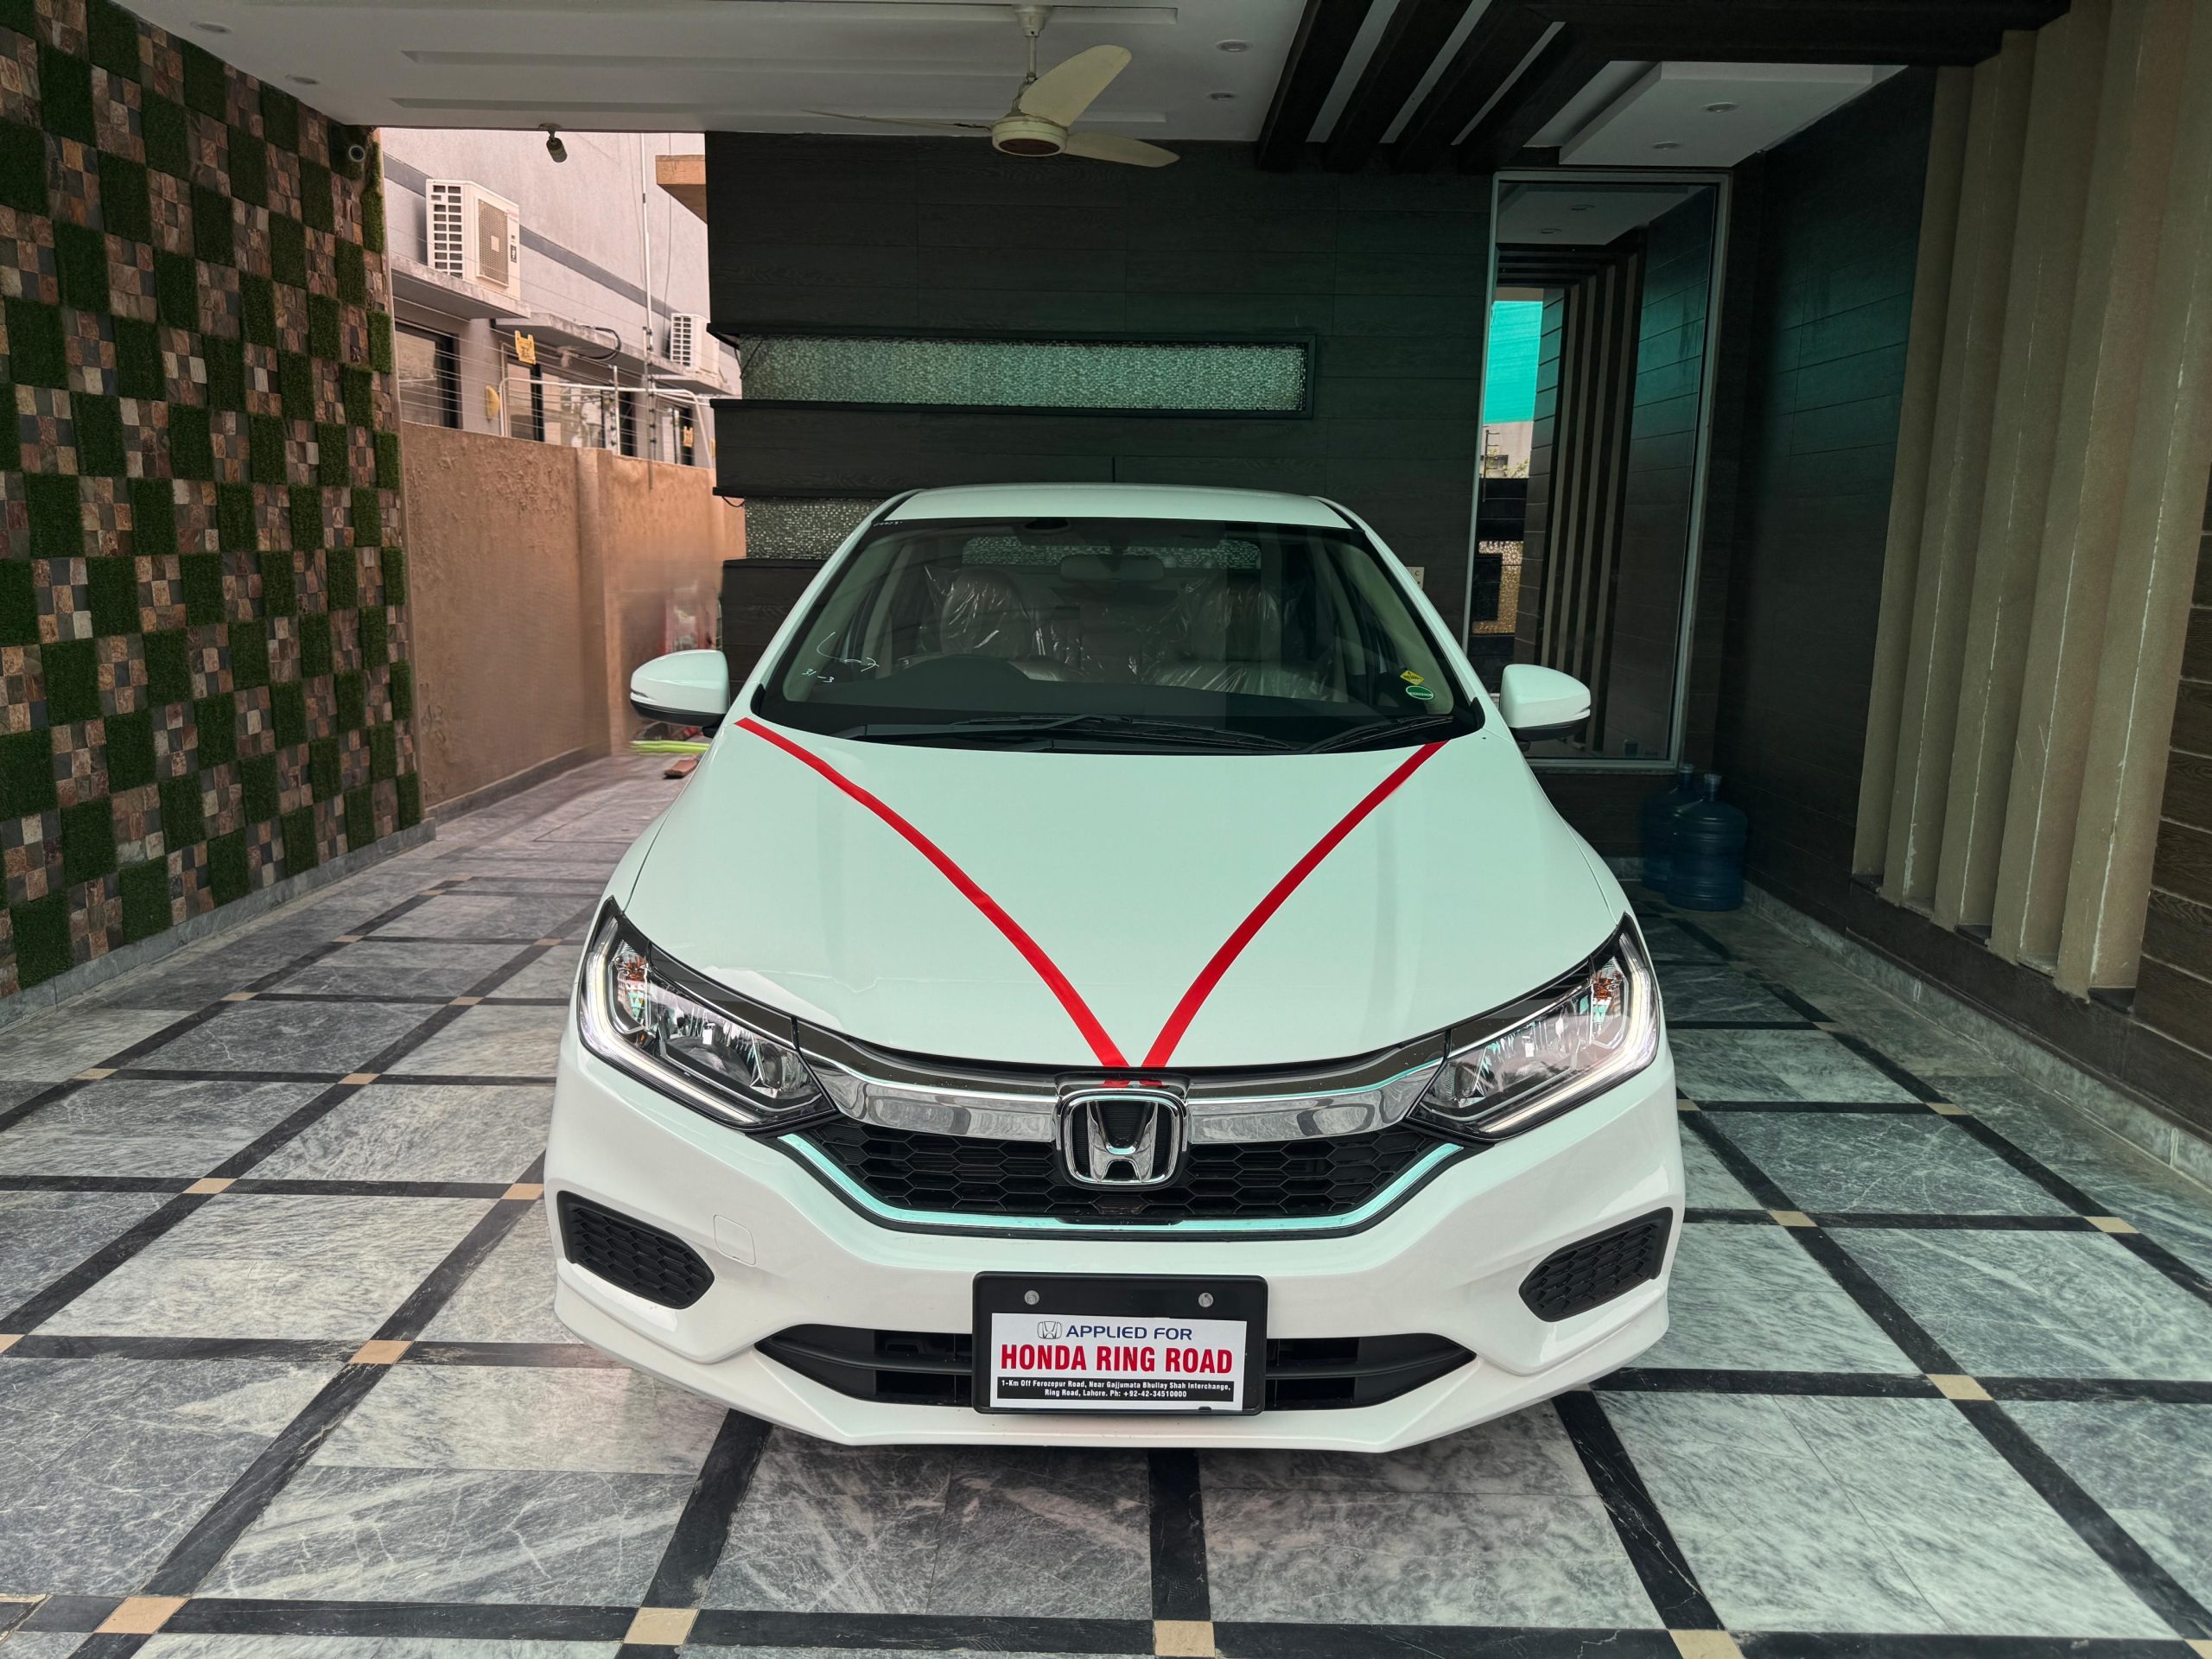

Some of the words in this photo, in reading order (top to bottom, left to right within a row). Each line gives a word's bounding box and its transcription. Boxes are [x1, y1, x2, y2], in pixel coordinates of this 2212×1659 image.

[1065, 1325, 1147, 1339] APPLIED
[1154, 1327, 1192, 1340] FOR
[1001, 1344, 1087, 1370] HONDA
[1096, 1345, 1155, 1372] RING
[1166, 1347, 1233, 1374] ROAD
[1033, 1380, 1066, 1389] Ferozepur
[1045, 1389, 1060, 1397] Ring
